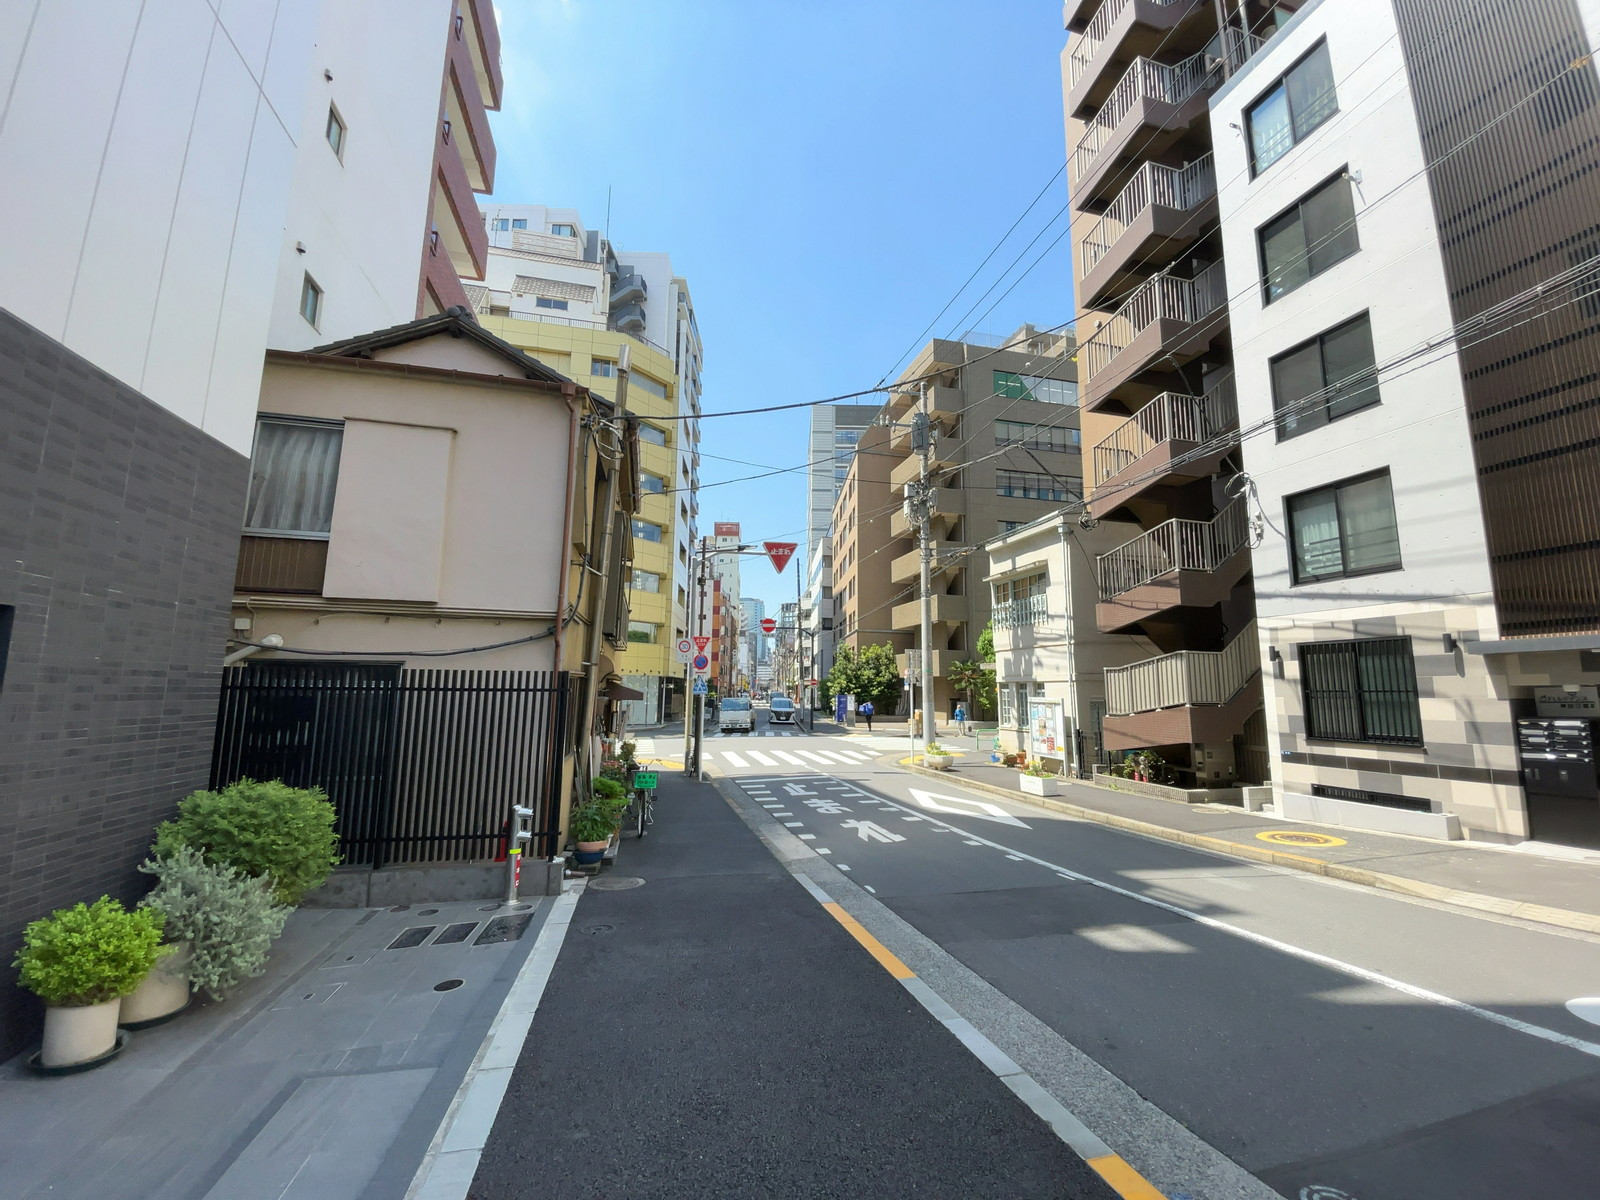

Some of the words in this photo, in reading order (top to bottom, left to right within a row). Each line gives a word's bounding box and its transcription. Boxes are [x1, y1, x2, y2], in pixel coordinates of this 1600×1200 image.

[770, 547, 791, 556] 止まれ
[782, 782, 908, 844] 止まれ
